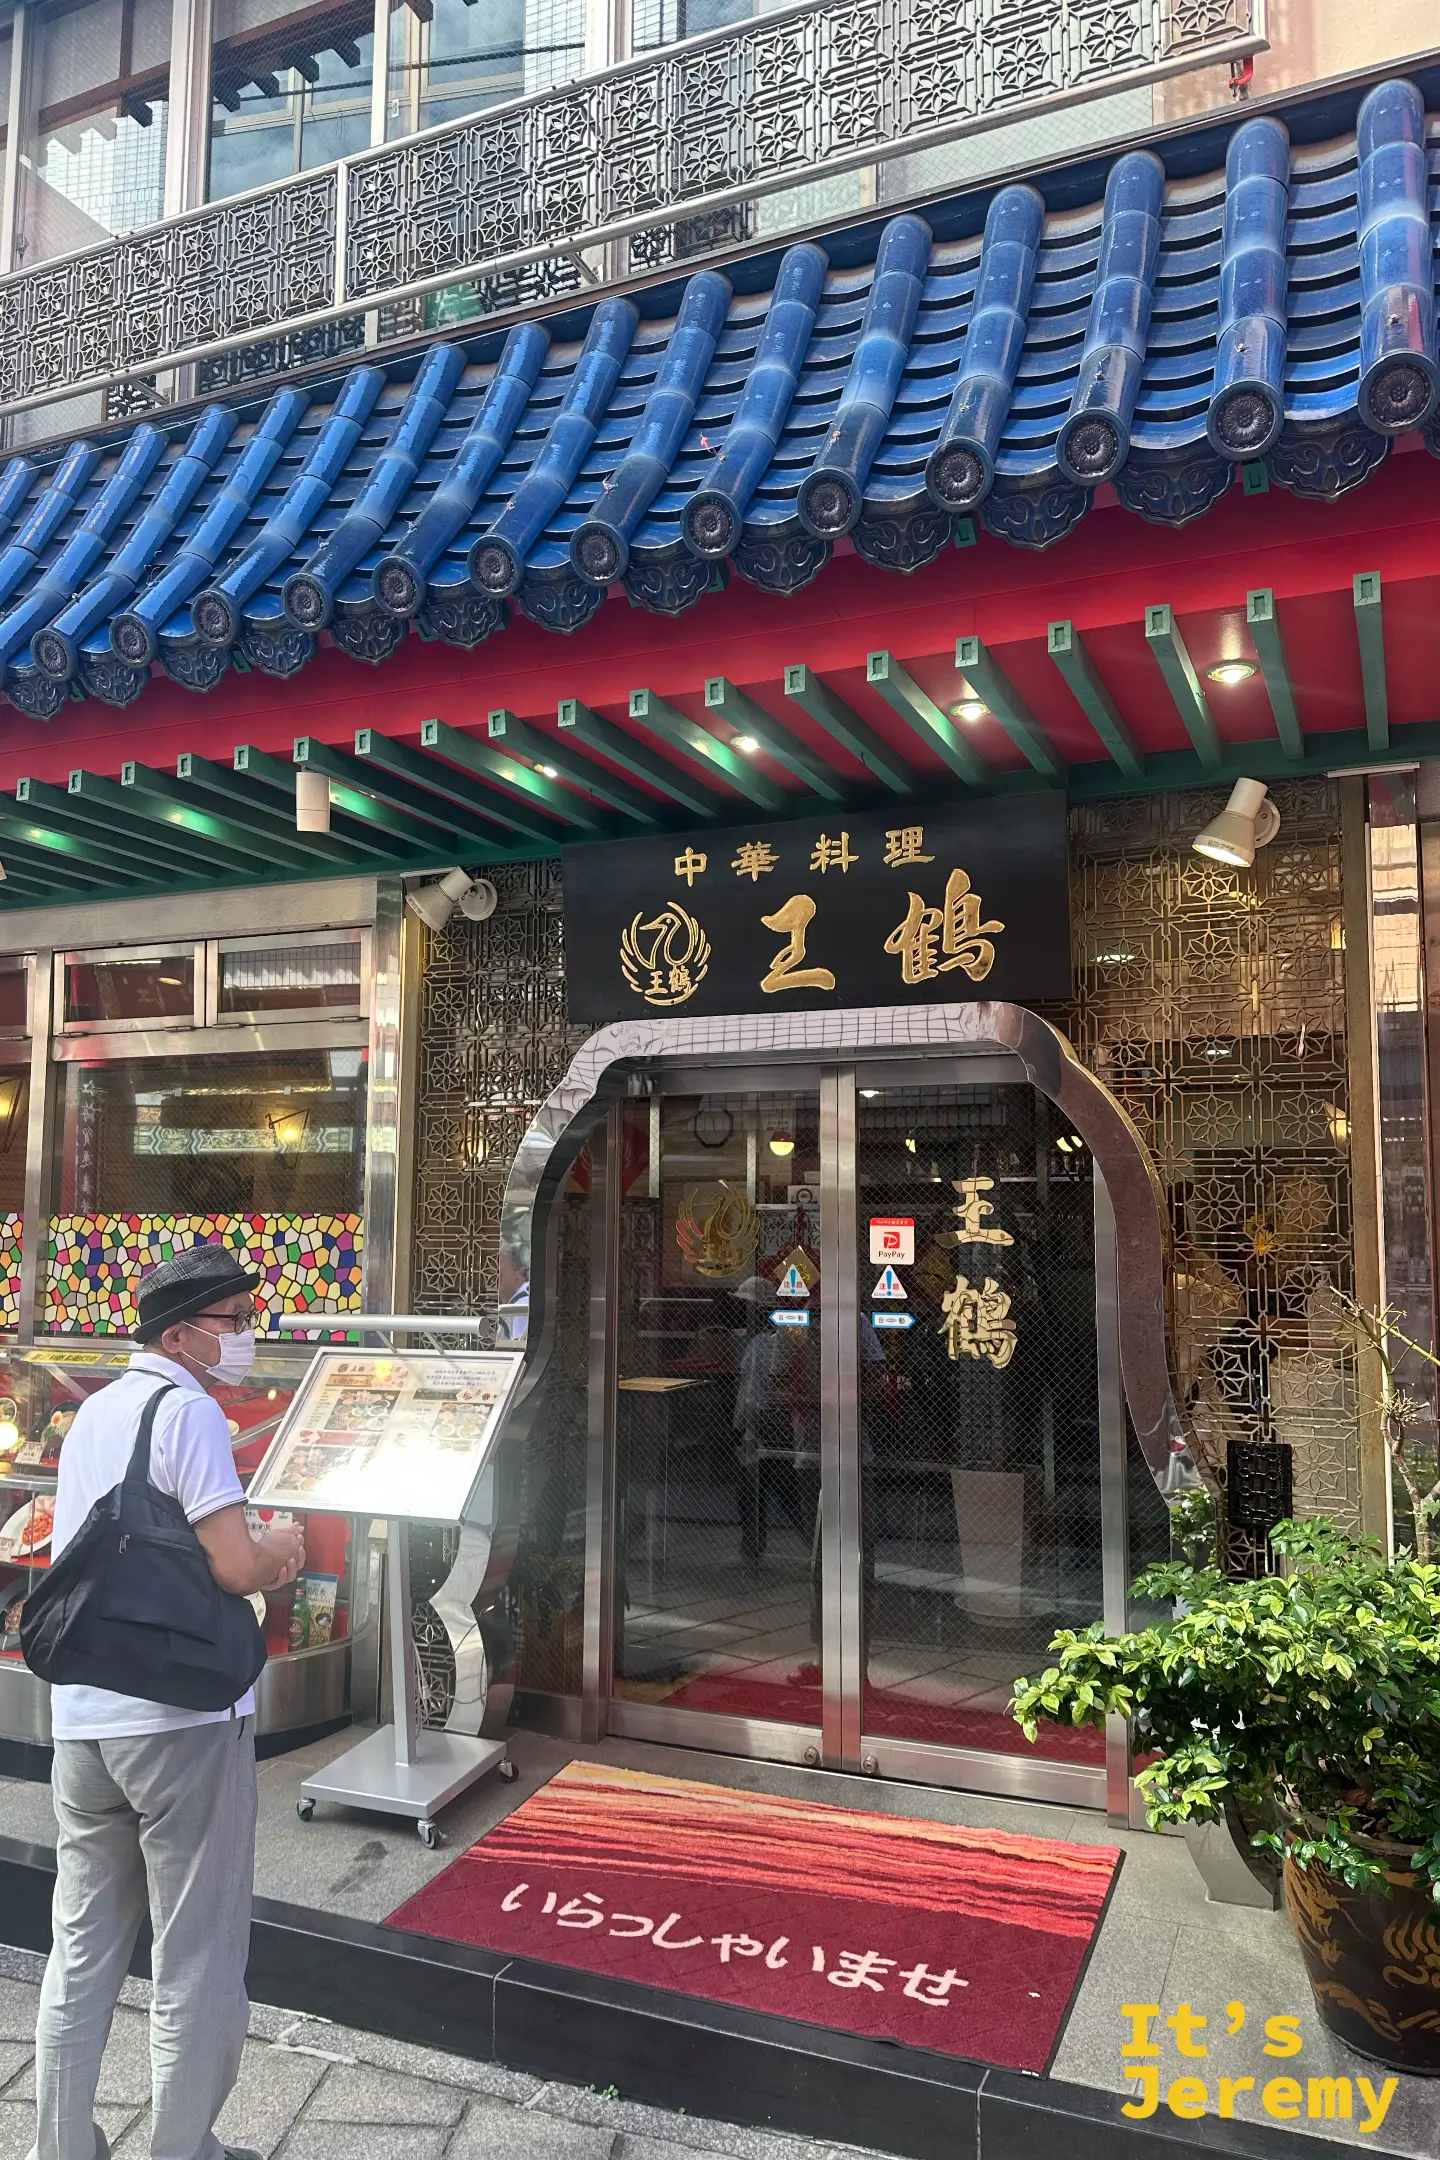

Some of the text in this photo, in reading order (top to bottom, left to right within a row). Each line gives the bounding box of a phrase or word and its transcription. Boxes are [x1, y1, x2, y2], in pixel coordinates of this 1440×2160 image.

[673, 826, 936, 887] 中華料理
[760, 868, 1005, 994] 王鶴
[878, 1250, 906, 1259] PayPay
[934, 1176, 1017, 1369] 王鶴
[500, 1883, 969, 2007] いらっしゃいませ
